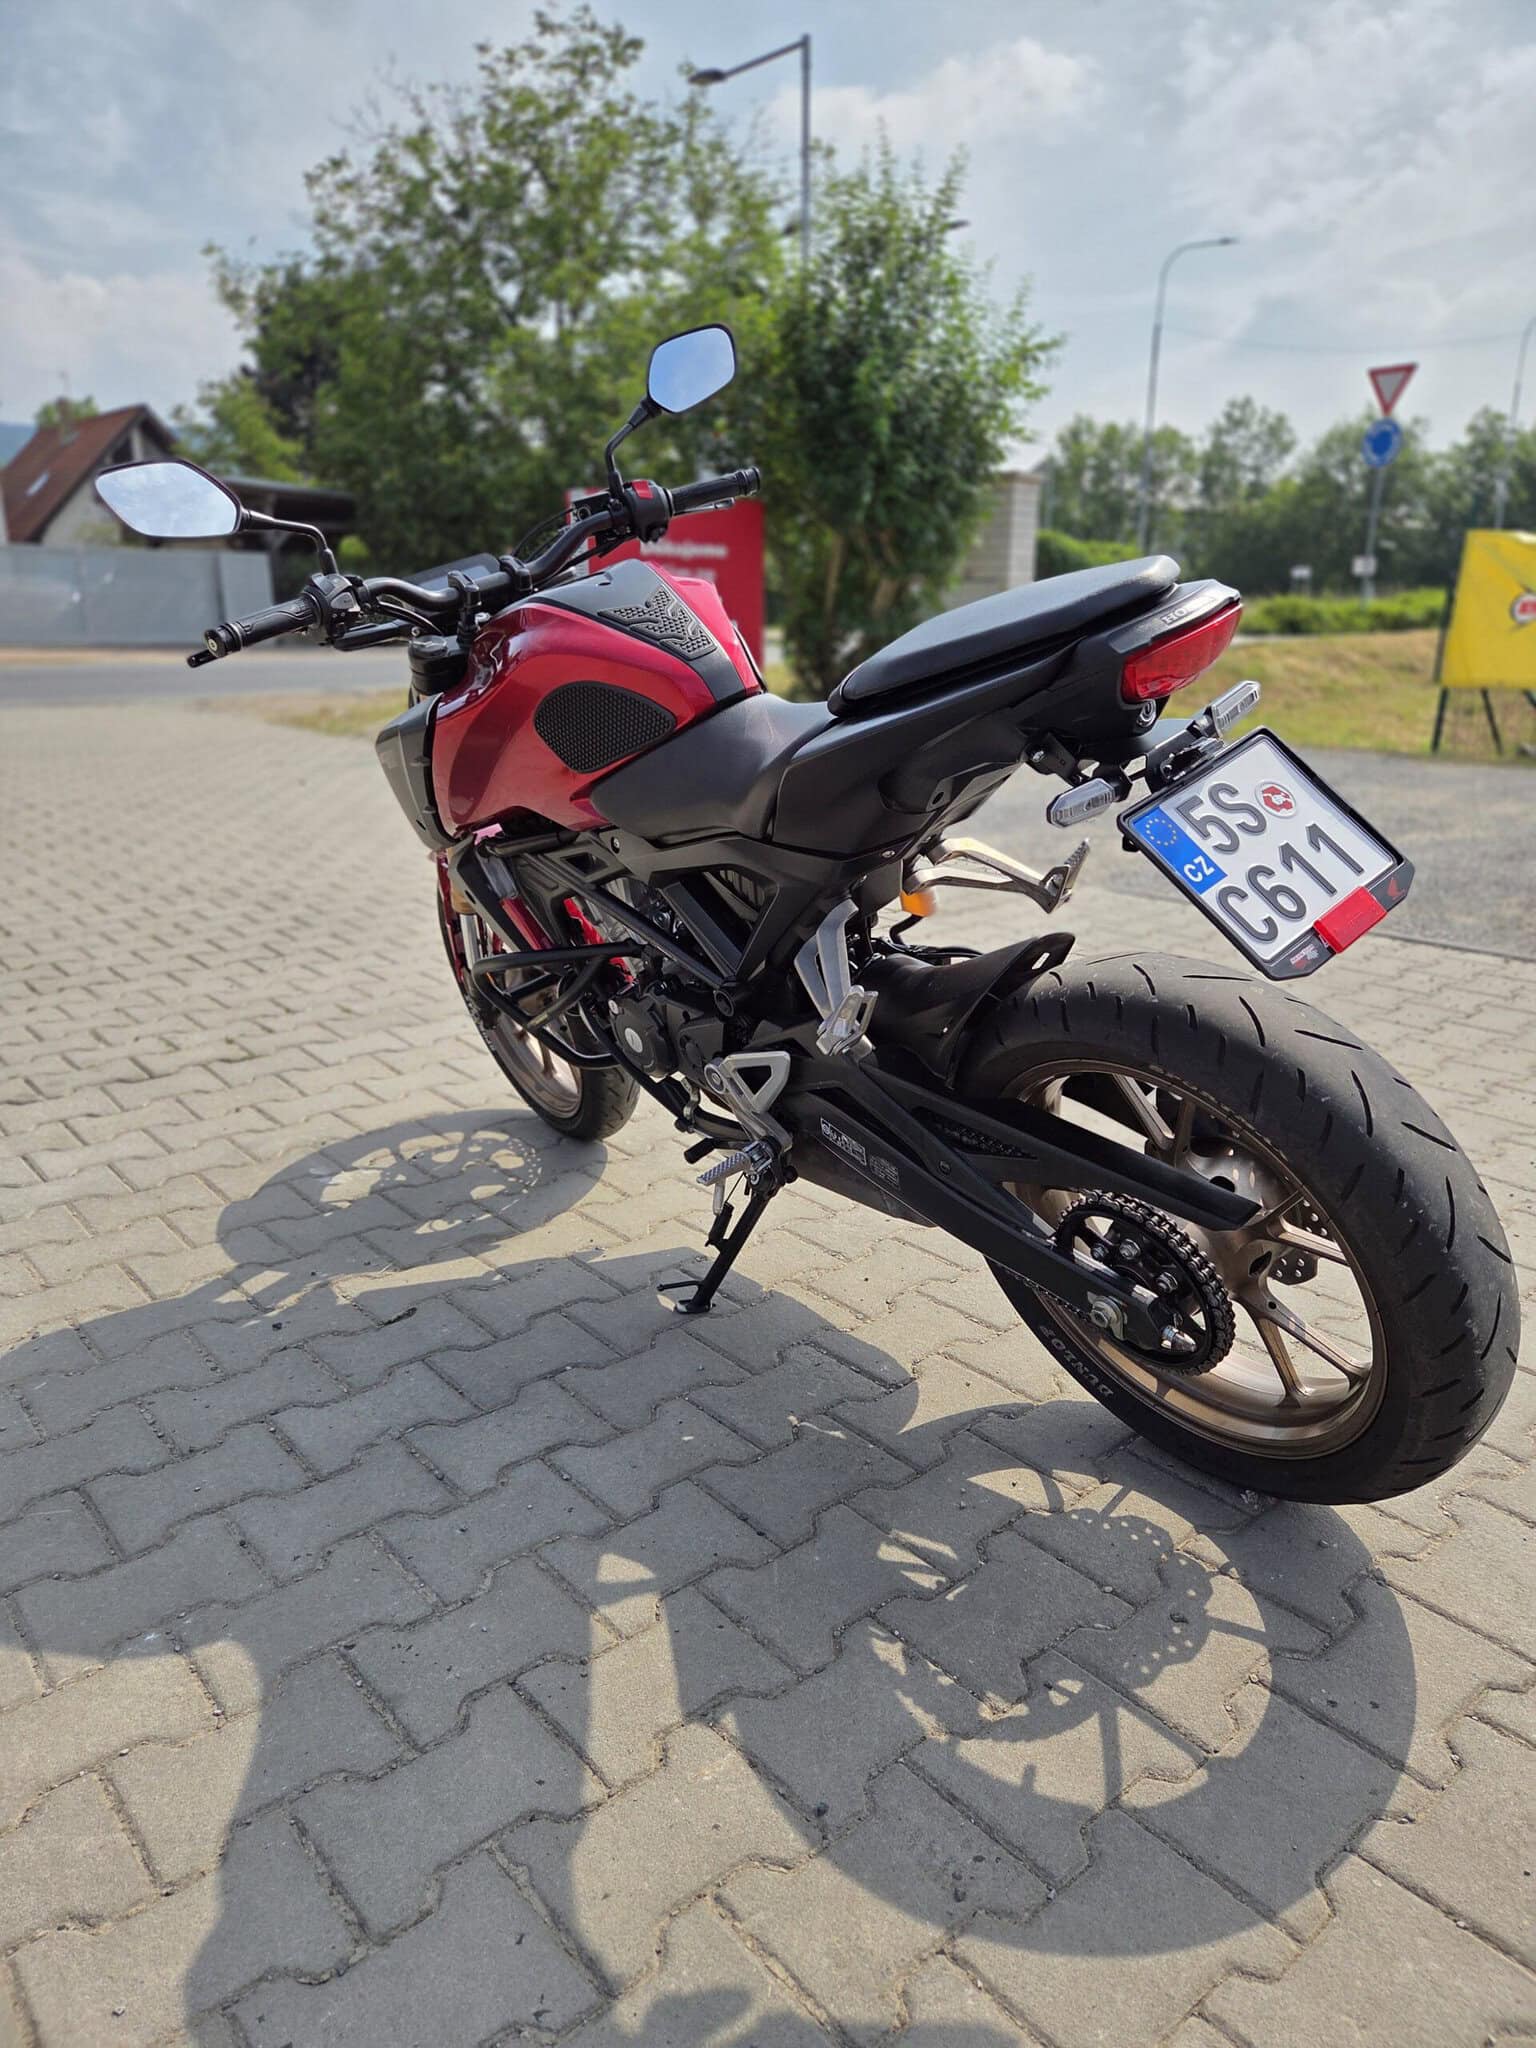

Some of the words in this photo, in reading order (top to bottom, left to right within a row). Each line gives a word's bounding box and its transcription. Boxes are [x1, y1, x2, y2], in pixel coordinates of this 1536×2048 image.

[1175, 782, 1268, 855] 5S
[1184, 856, 1215, 883] CZ
[1217, 823, 1365, 942] C611
[1039, 1325, 1115, 1397] DUNLOP
